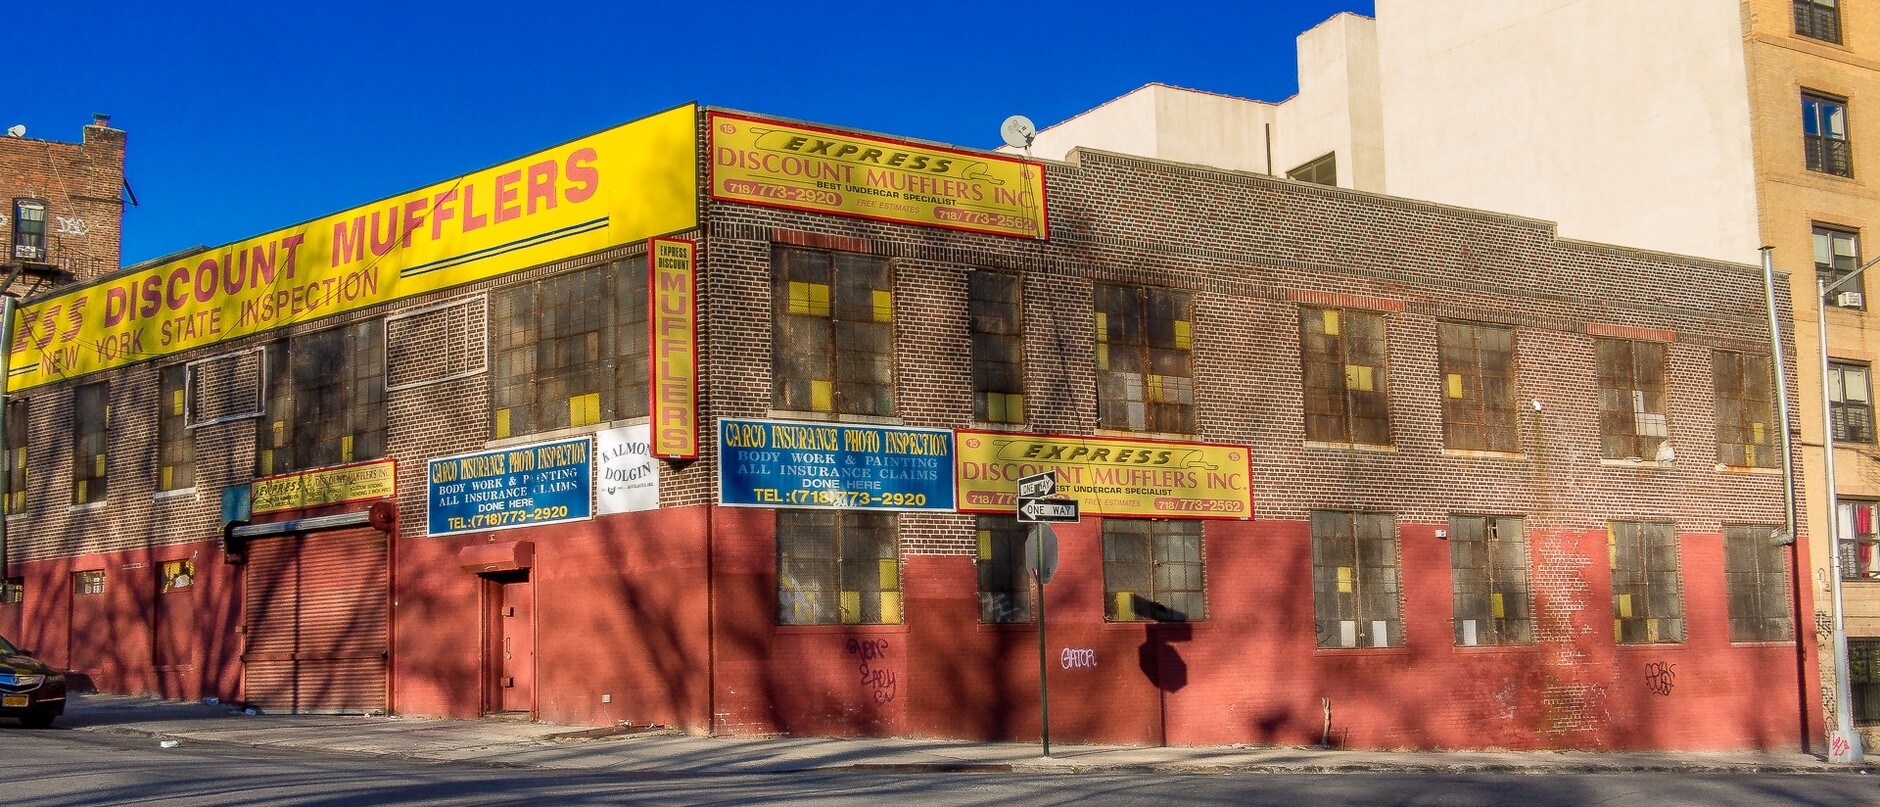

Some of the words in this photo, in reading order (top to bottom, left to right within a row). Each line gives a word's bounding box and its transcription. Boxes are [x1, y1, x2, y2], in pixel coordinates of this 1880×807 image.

[722, 124, 734, 133] 15
[781, 136, 952, 173] EXPRESS
[717, 147, 856, 183] DISCOUNT
[866, 168, 984, 201] MUFFLERS
[994, 187, 1039, 210] INC.
[817, 181, 841, 190] BEST
[845, 185, 899, 198] UNDERCAR
[903, 193, 957, 206] SPECIALIST
[857, 198, 876, 207] FREE
[879, 202, 920, 214] ESTIMATES
[104, 233, 304, 328] DISCOUNT
[332, 147, 599, 268] MUFFLERS
[660, 246, 687, 258] EXPRESS
[659, 258, 689, 270] DISCOUNT
[41, 344, 80, 377] NEW
[96, 327, 144, 363] YORK
[161, 307, 222, 346] STATE
[240, 267, 379, 327] INSPECTION
[661, 272, 688, 450] MUFFLERS
[725, 423, 767, 448] CARCO
[771, 425, 839, 451] INSURANCE
[844, 430, 880, 453] PHOTO
[884, 432, 947, 456] INSPECTION
[432, 460, 457, 484] CARCO
[460, 453, 506, 480] INSURANCE
[509, 449, 534, 473] PHOTO
[538, 442, 586, 469] INSPECTION
[738, 451, 780, 462] BODY
[791, 453, 836, 464] WORK
[845, 455, 856, 465] &
[865, 456, 938, 468] PAINTING
[1022, 444, 1172, 465] EXPRESS
[605, 462, 651, 481] DOLGIN
[738, 464, 771, 475] ALL
[780, 464, 871, 478] INSURANCE
[879, 469, 938, 480] CLAIMS
[1095, 468, 1197, 489] MUFFLERS
[1206, 473, 1247, 491] INC.
[439, 483, 466, 496] BODY
[472, 478, 502, 491] WORK
[508, 476, 517, 486] &
[802, 478, 840, 489] DONE
[846, 479, 882, 490] HERE
[1022, 483, 1034, 494] ONE
[1073, 485, 1122, 494] UNDERCAR
[1125, 487, 1172, 496] SPECIALIST
[439, 496, 459, 507] ALL
[465, 487, 527, 503] INSURANCE
[533, 481, 577, 495] CLAIMS
[1104, 499, 1141, 507] ESTIMATES
[479, 501, 504, 512] DONE
[509, 498, 533, 508] HERE
[1027, 505, 1045, 515] ONE
[1053, 505, 1070, 516] WAY
